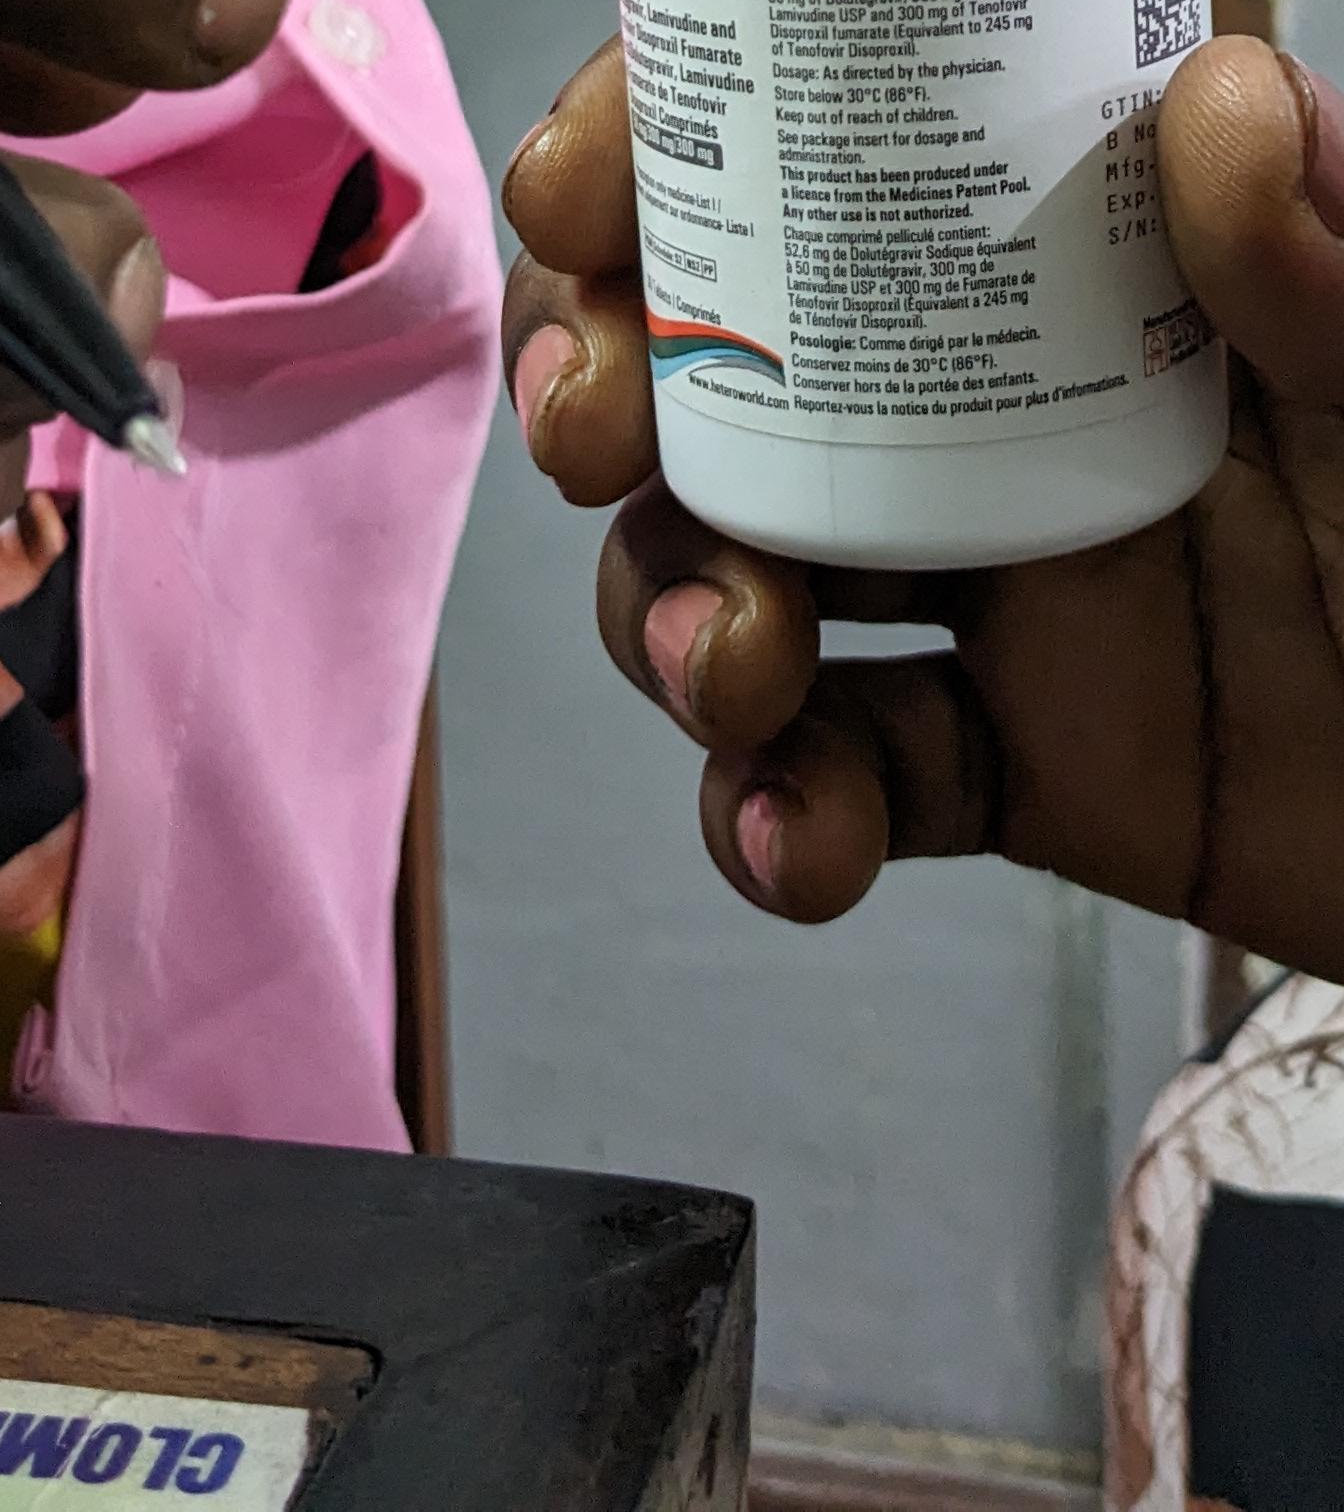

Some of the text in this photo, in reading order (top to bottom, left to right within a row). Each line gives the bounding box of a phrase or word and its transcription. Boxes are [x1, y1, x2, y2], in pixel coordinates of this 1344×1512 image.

[647, 3, 707, 35] Lamivudine
[711, 21, 736, 40] and
[769, 7, 835, 22] Lamivudine
[839, 8, 867, 22] USP
[871, 8, 893, 21] and
[898, 6, 924, 20] 300
[928, 7, 948, 21] mg
[952, 3, 965, 17] of
[770, 15, 1032, 41] Disoproxil fumarate (Equivalent to 245 mg
[681, 39, 743, 66] Fumarate
[772, 39, 920, 60] of Tenofovir Disoproxil).
[680, 63, 755, 94] Lamivudine
[773, 58, 1005, 82] Dosage: directed the physician.
[672, 87, 727, 116] Tenofovir
[775, 85, 805, 102] Store
[808, 88, 843, 103] below
[659, 107, 719, 140] Comprimés
[776, 106, 958, 125] Keep out of reach of children.
[778, 126, 985, 150] See package insert for dosage and
[1106, 130, 1118, 150] B
[779, 149, 866, 165] administration.
[779, 161, 1008, 184] This product has been produced under
[791, 176, 1031, 202] licence from the Medicines Patent Pool.
[783, 202, 974, 222] Any other use not authorized.
[784, 225, 990, 245] Chaque comprimé pelliculé contient:
[813, 236, 1036, 264] mg de Dolutégravir Sodique équivalent
[796, 259, 994, 280] 50 mg de Dolutégravir, 300 mg de
[786, 270, 1035, 296] Lamivudine USP 300 mg de Fumarate de
[676, 296, 721, 326] Comprimés
[787, 290, 1028, 313] Ténofovir Disoproxil (Équivalent 245 mg
[789, 311, 927, 331] de Ténofovir Disoproxil).
[790, 326, 1040, 352] Posologie: Comme dirigé par médecin.
[792, 353, 850, 372] Conservez
[854, 359, 890, 372] moins
[894, 358, 909, 372] de
[689, 375, 789, 410] www.heteroworld.com
[793, 371, 1039, 395] Conserver hors de portée des enfants.
[794, 374, 1129, 416] Reportez-vous notice produit pour plus d'informations.
